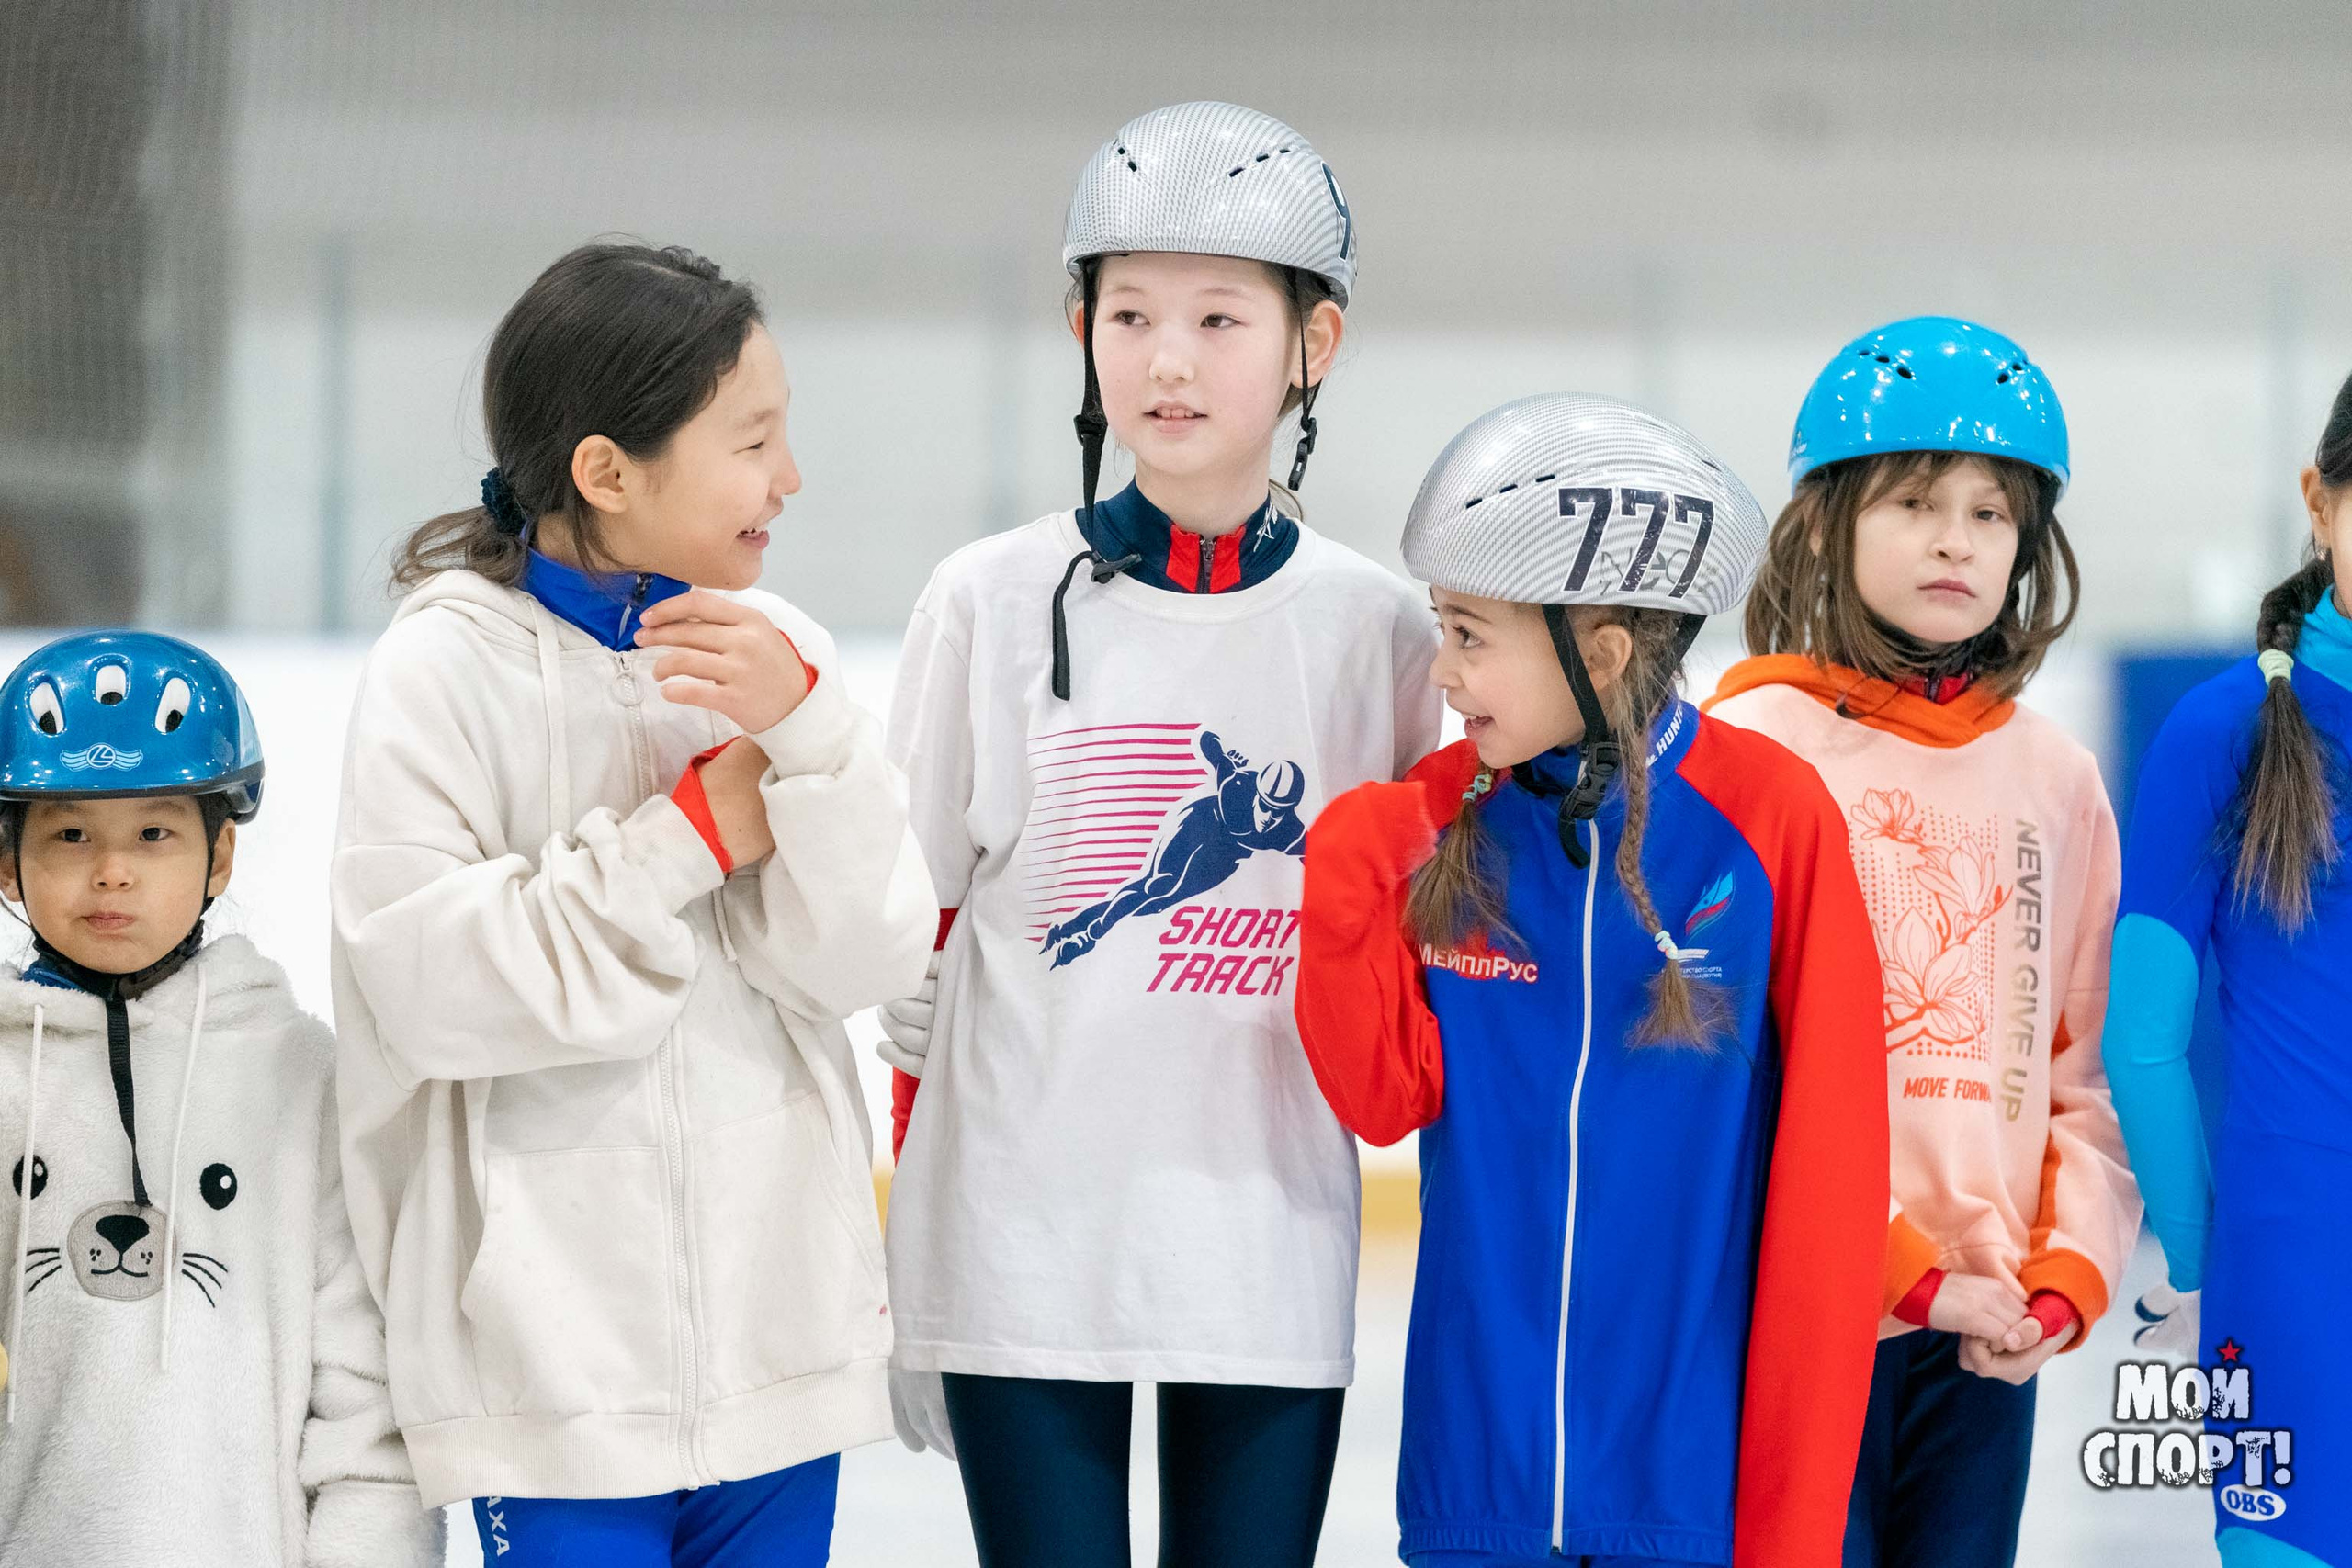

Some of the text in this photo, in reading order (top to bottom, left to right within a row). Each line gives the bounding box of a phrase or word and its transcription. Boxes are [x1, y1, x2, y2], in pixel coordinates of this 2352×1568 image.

[1558, 487, 1715, 600] 777
[1146, 953, 1295, 996] TRACK
[1999, 818, 2042, 1122] NEVER GIVE UP
[1903, 1077, 1992, 1102] MOVE FORW
[2225, 1489, 2277, 1517] OBS
